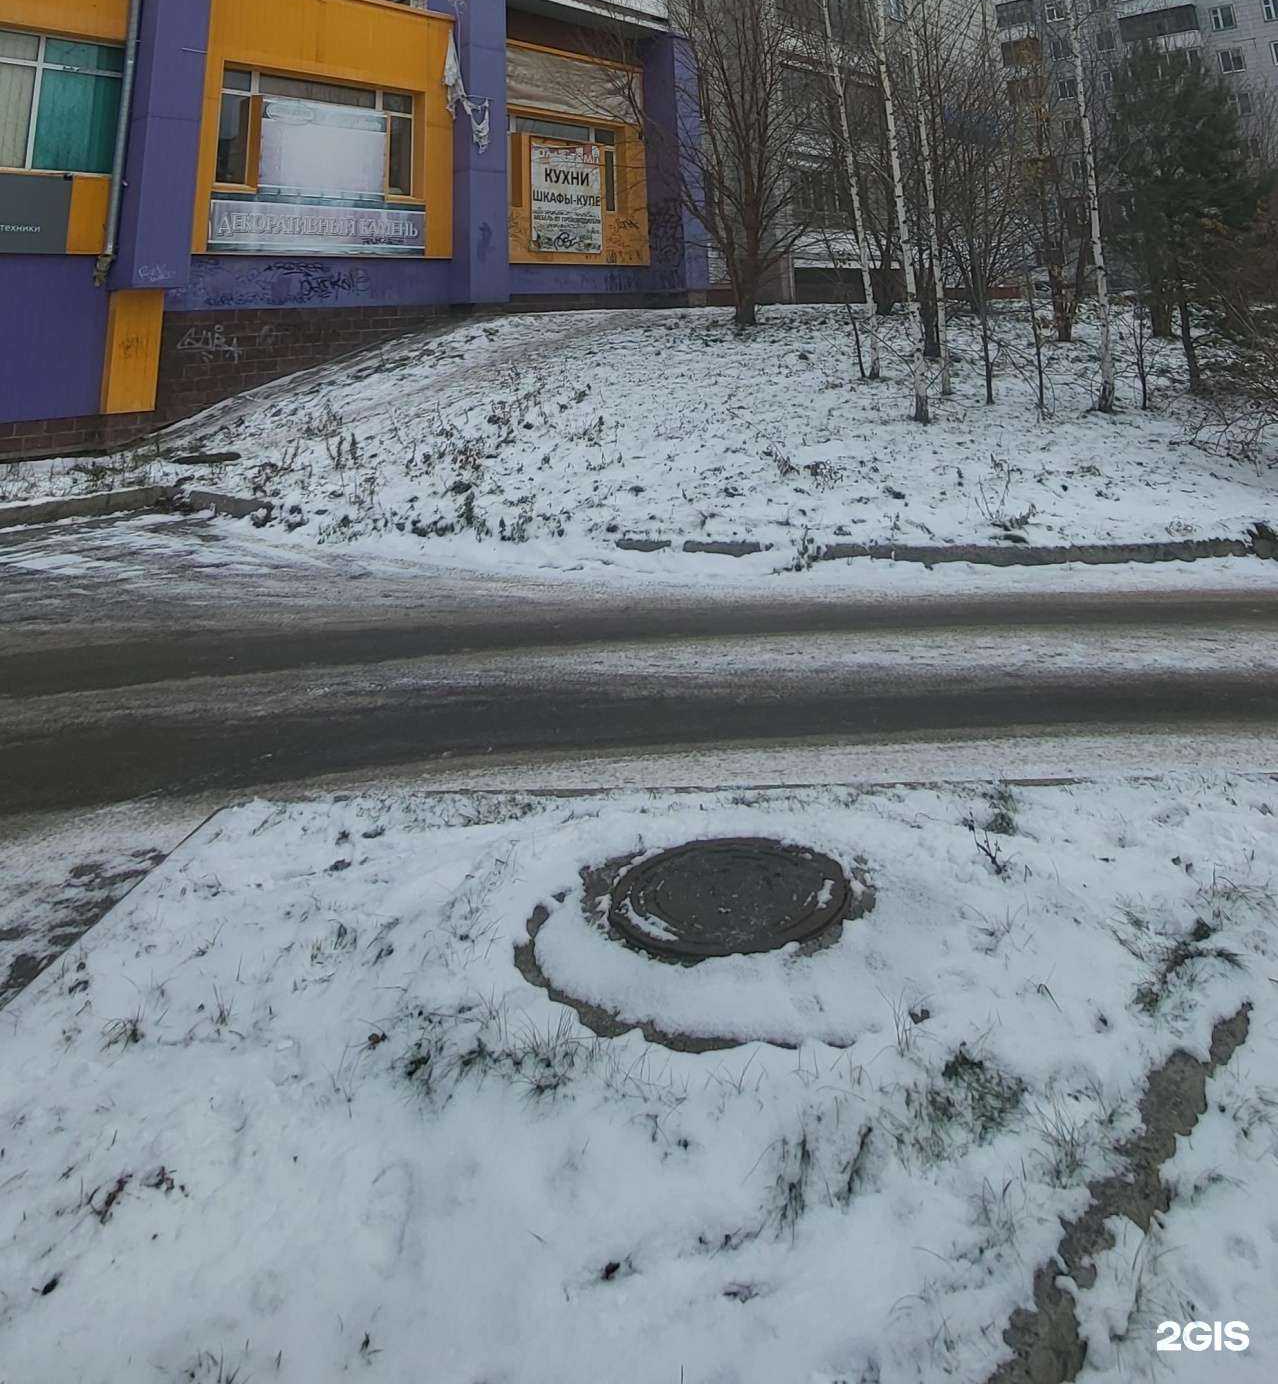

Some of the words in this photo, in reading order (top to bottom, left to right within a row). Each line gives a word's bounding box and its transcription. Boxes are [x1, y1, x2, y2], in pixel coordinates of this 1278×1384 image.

[544, 167, 590, 187] КУХНИ
[532, 189, 601, 207] ШКАФЫ-КУПЕ
[216, 211, 355, 238] ДЕКОРАТИВНЫЙ
[359, 217, 419, 239] КАМЕНЬ
